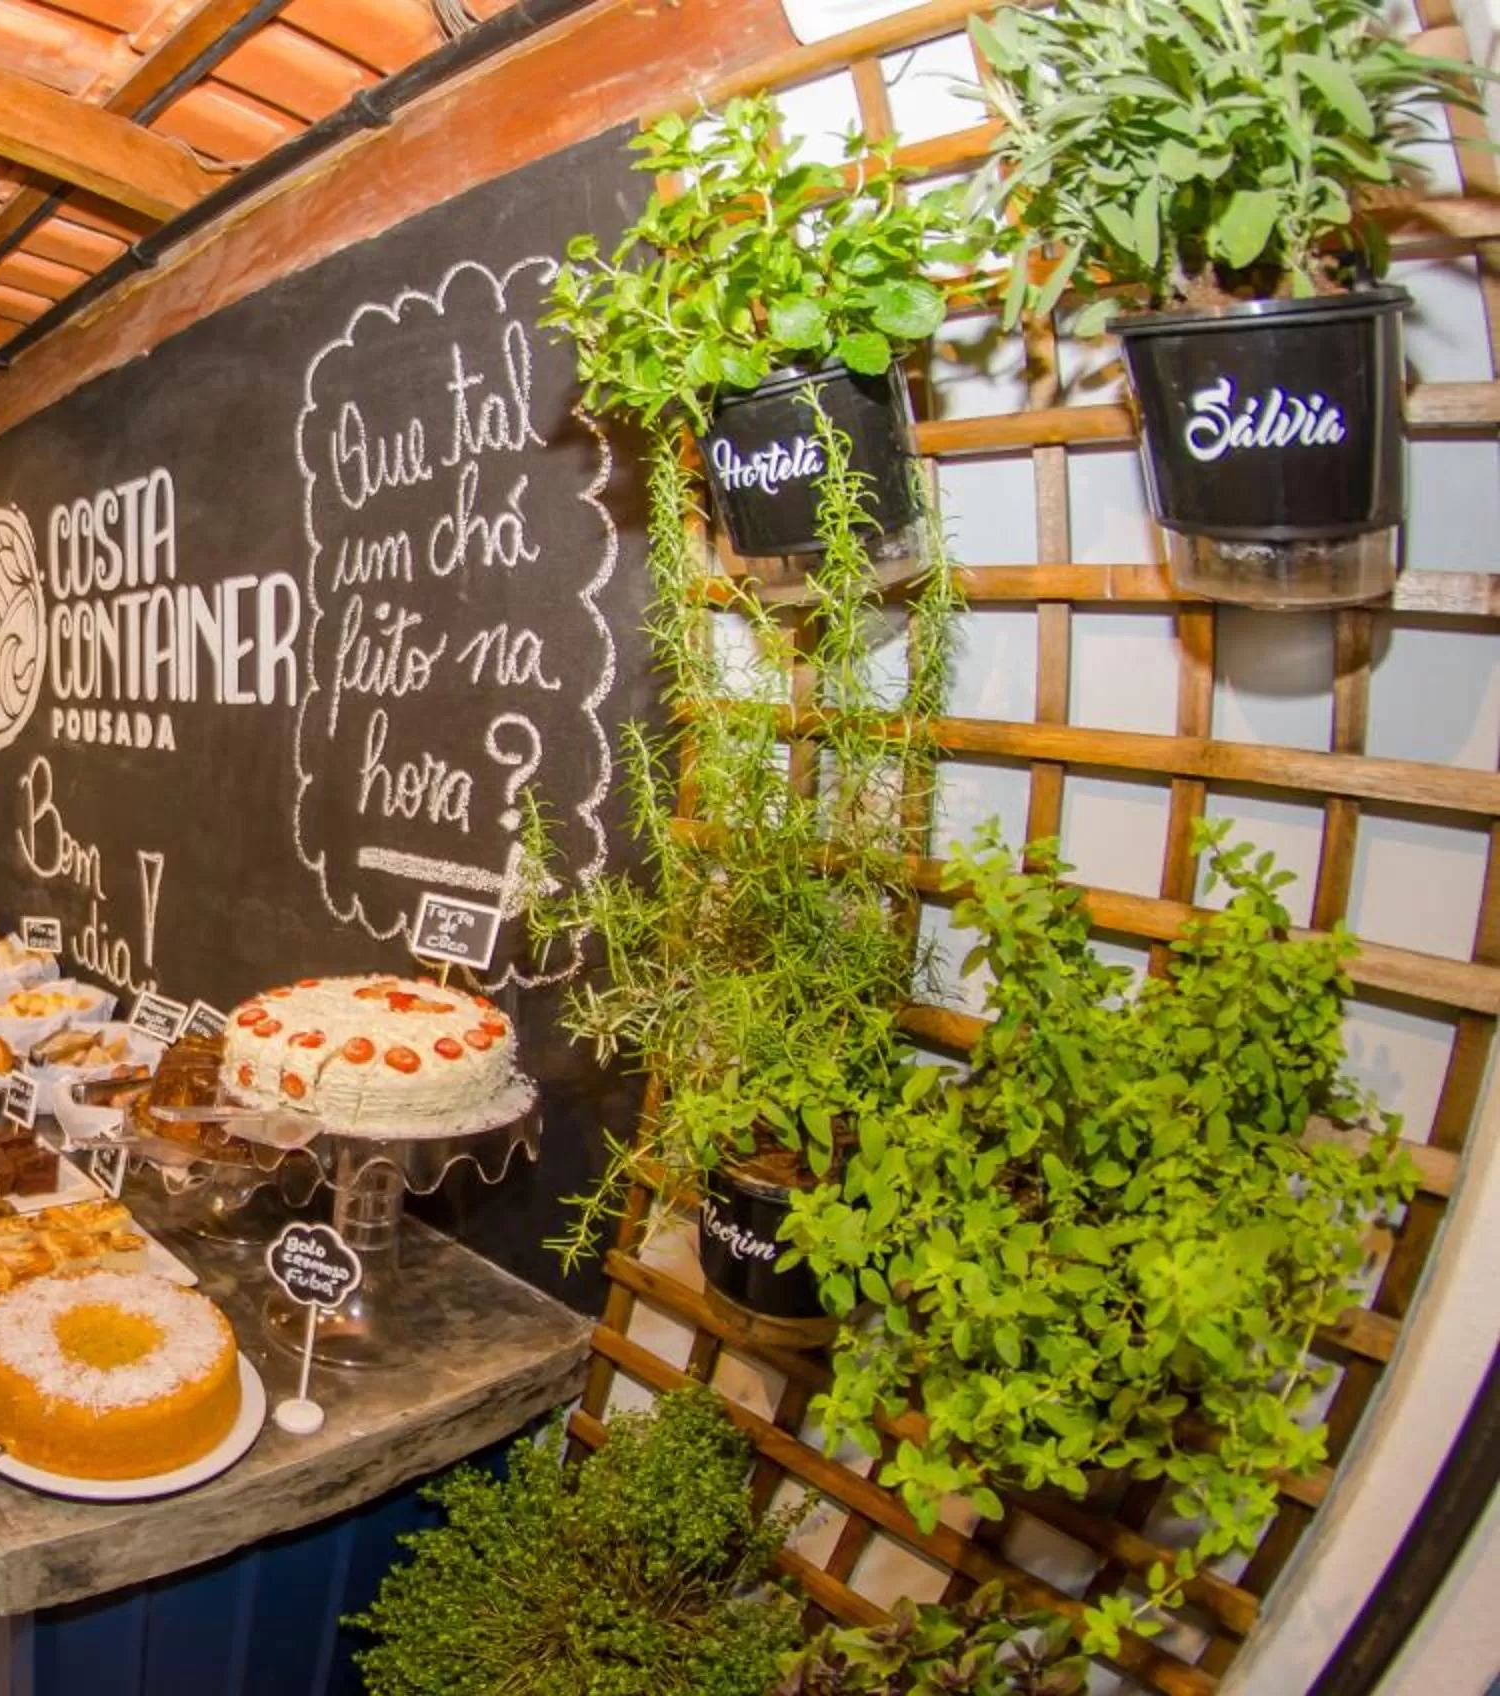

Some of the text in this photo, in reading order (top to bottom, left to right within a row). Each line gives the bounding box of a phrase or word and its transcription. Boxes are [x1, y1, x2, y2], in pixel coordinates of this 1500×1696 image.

[332, 319, 548, 510] Que tal
[1184, 376, 1346, 462] Sálvia
[50, 466, 176, 600] COSTA
[331, 459, 541, 593] um chá
[50, 572, 301, 708] CONTAINER
[327, 594, 563, 739] feito na
[51, 706, 177, 751] POUSADA
